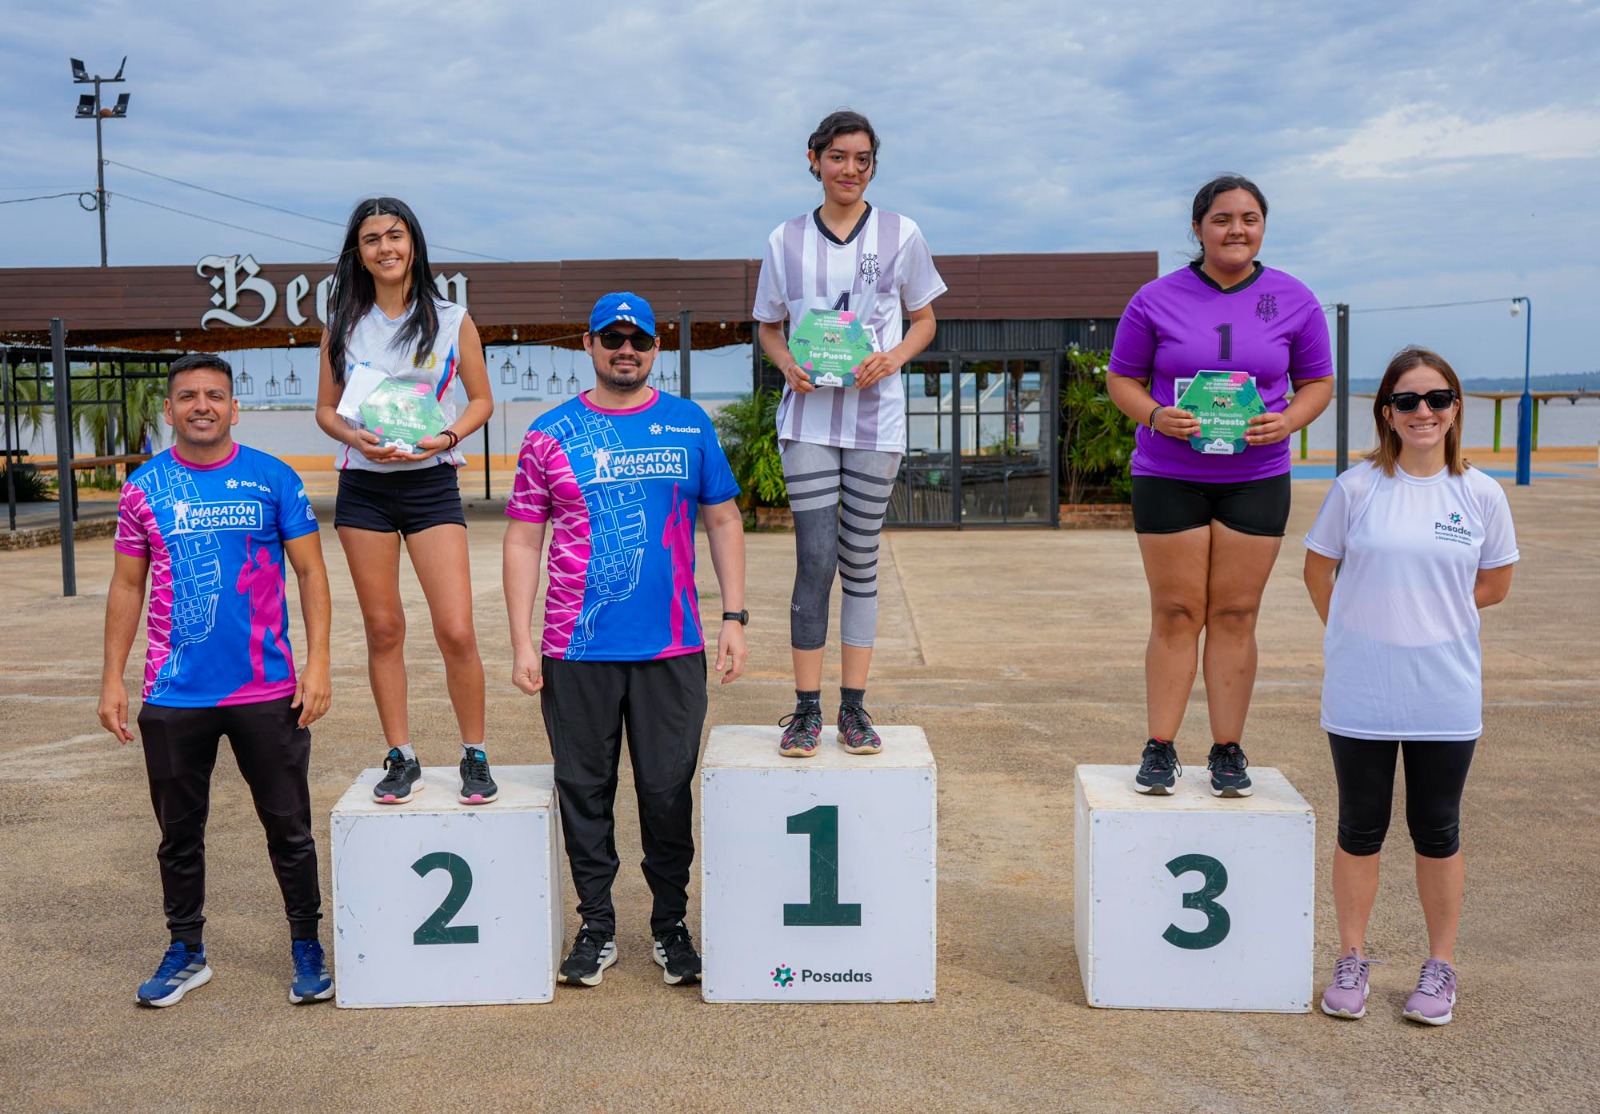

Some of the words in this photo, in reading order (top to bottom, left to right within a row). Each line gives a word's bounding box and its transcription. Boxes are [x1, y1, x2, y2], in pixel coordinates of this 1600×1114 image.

[1213, 323, 1232, 361] 1
[809, 350, 822, 358] 1er
[823, 351, 852, 361] Puesto
[379, 415, 395, 425] 2do
[396, 418, 427, 430] Puesto
[1214, 417, 1246, 426] Puesto
[665, 424, 701, 434] Posadas
[613, 450, 681, 465] MARATÓN
[613, 463, 683, 477] POSADAS
[191, 503, 256, 517] MARATÓN
[191, 516, 257, 529] POSADAS
[783, 805, 861, 926] 1
[410, 851, 479, 945] 2
[1162, 853, 1231, 950] 3
[801, 969, 872, 982] Posadas
